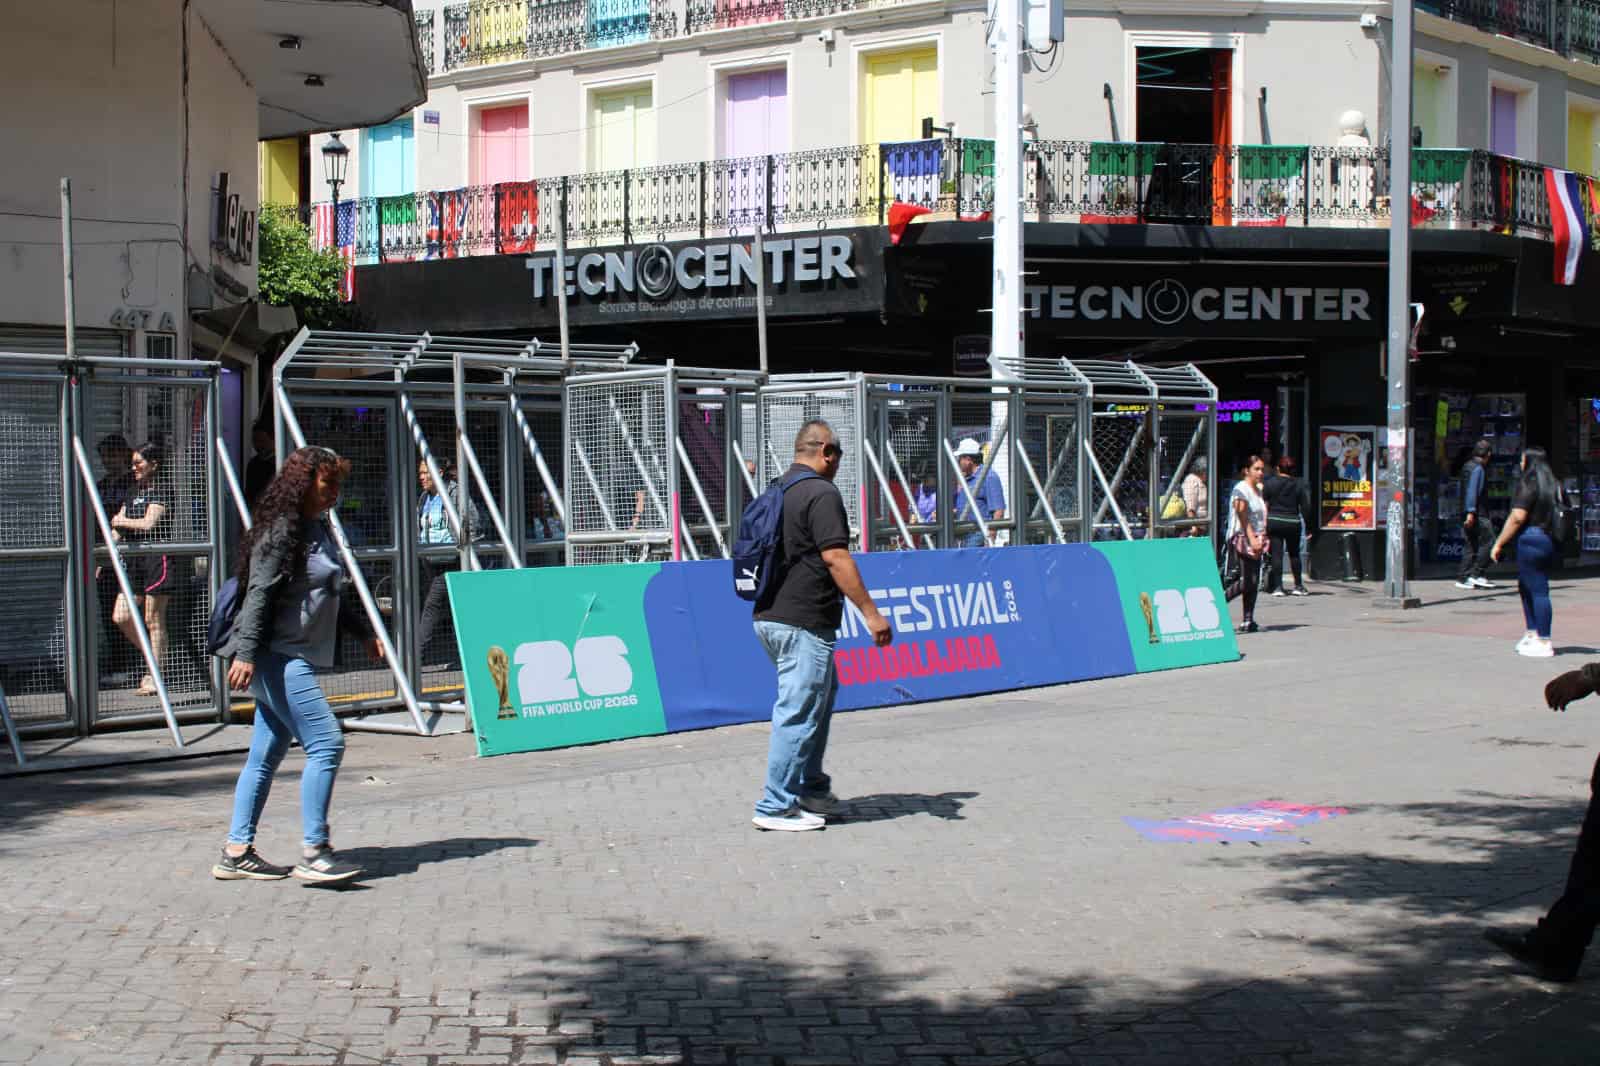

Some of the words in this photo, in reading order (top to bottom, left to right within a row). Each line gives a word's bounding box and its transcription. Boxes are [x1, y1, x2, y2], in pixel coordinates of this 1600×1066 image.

[525, 235, 857, 298] TECNOCENTER
[110, 308, 153, 329] 447
[160, 311, 176, 330] A
[599, 302, 636, 313] Somos
[699, 296, 715, 309] de
[716, 295, 773, 308] confiana
[1023, 278, 1373, 324] TECNOCENTER
[1323, 481, 1331, 492] 3
[1332, 480, 1371, 492] NIVELES
[1003, 580, 1022, 623] 2026
[1153, 586, 1219, 635] 26
[513, 635, 633, 705] 26
[834, 634, 1002, 686] GUADALAJARA
[522, 704, 545, 718] FIFA
[546, 700, 583, 716] WORLD
[584, 698, 602, 710] CUP
[604, 695, 638, 708] 2026
